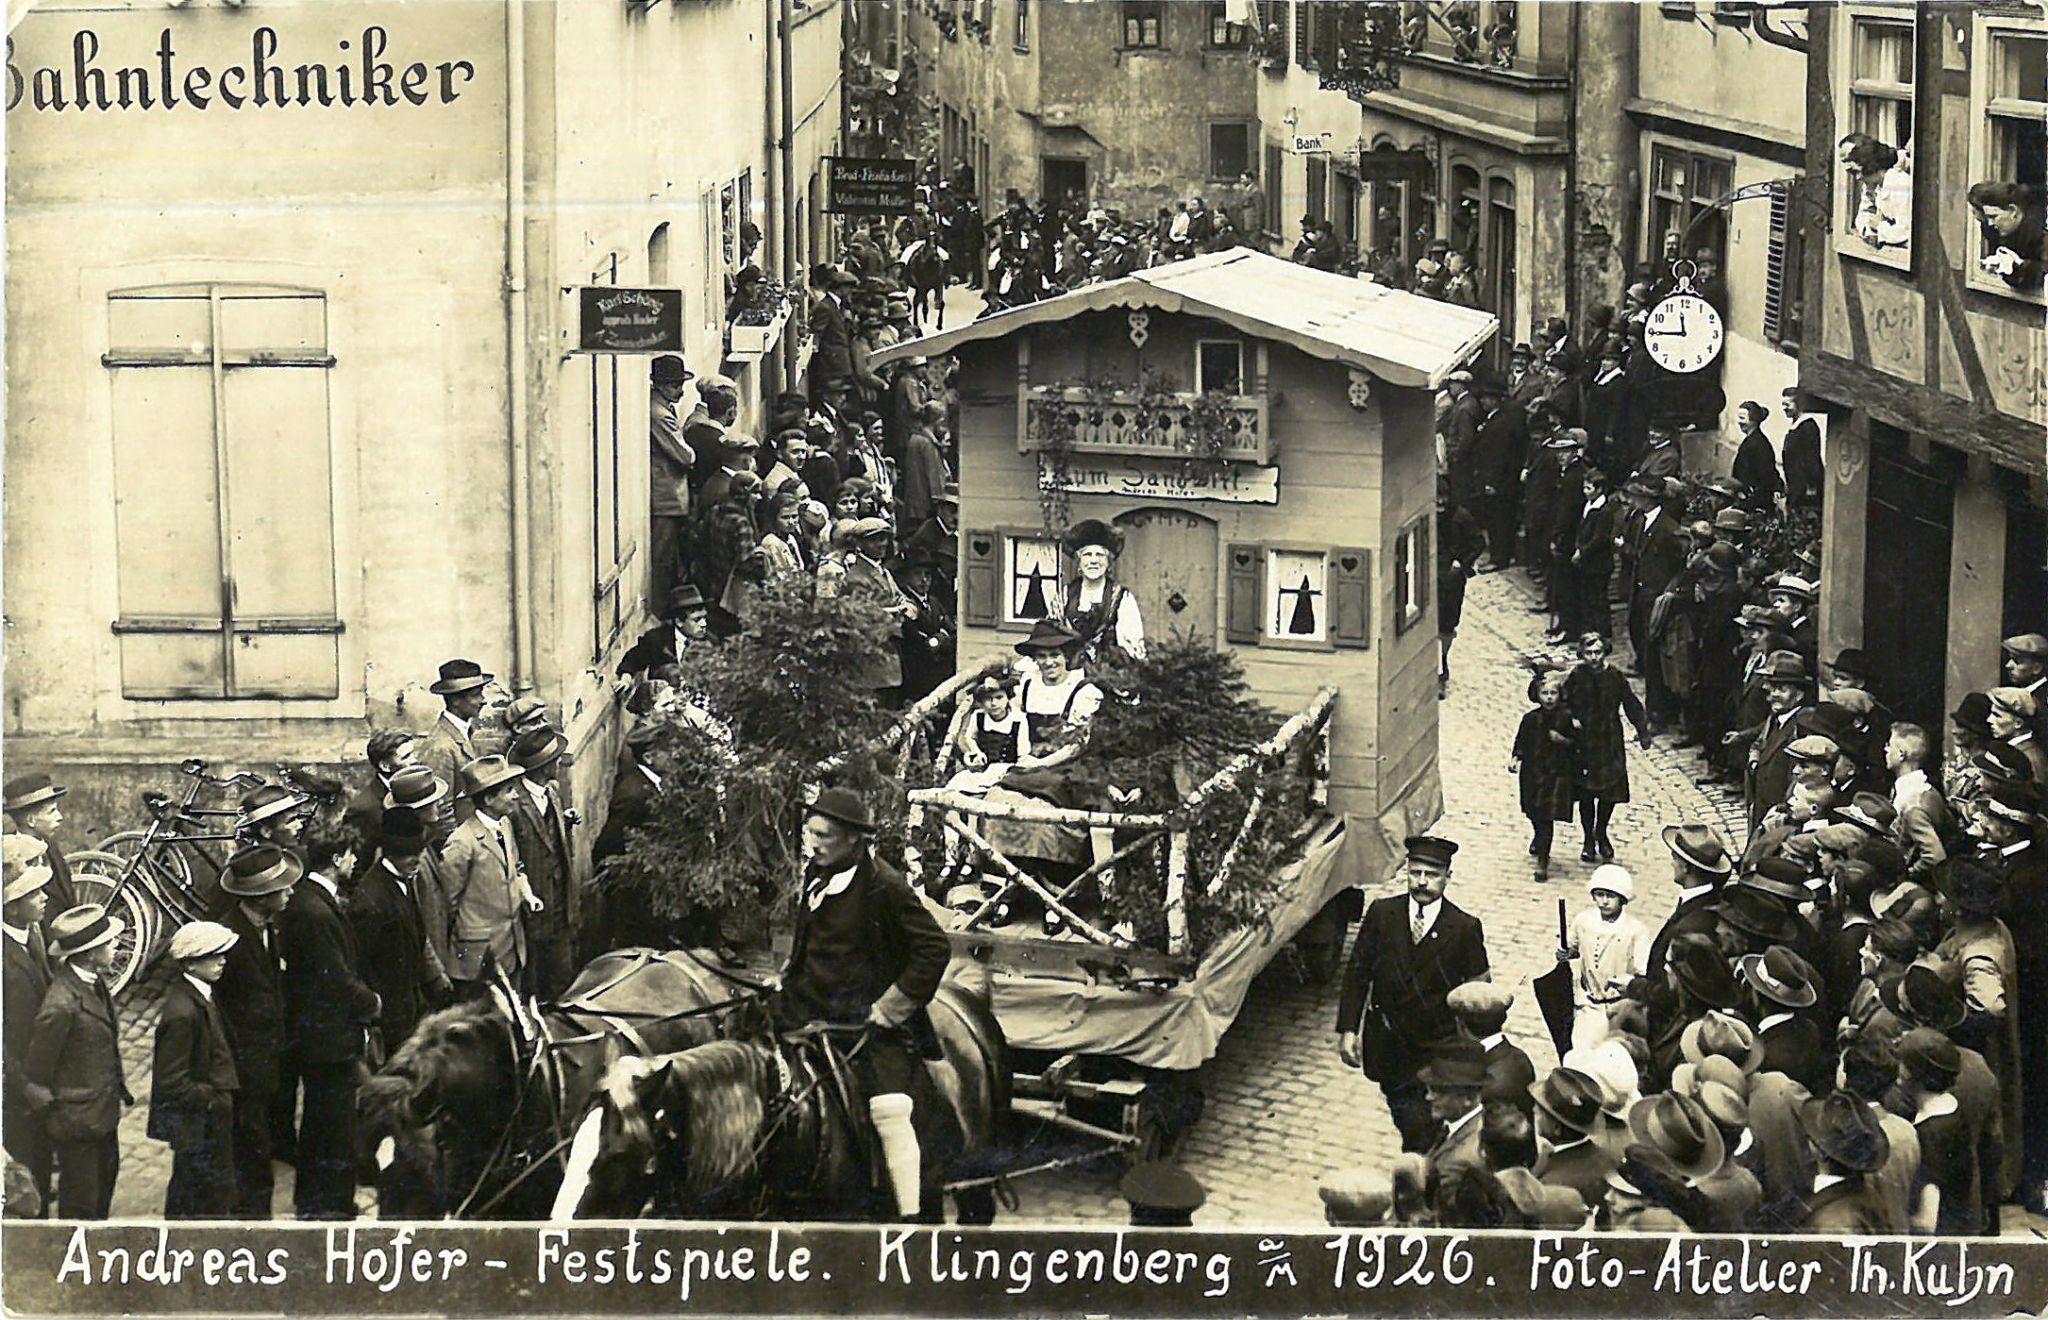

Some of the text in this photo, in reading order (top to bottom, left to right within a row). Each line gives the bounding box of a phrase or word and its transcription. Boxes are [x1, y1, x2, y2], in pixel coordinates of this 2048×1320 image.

[1296, 137, 1322, 150] Bank
[1664, 303, 1674, 313] 11
[1680, 299, 1691, 309] 12
[1699, 303, 1703, 314] 1
[1654, 313, 1665, 324] 10
[1708, 314, 1715, 324] 2
[1647, 327, 1655, 338] 9
[1712, 329, 1719, 340] 3
[1651, 342, 1659, 353] 8
[1706, 343, 1713, 354] 4
[1662, 353, 1669, 364] 7
[1696, 354, 1702, 364] 5
[1679, 359, 1686, 370] 6
[1056, 468, 1109, 487] um
